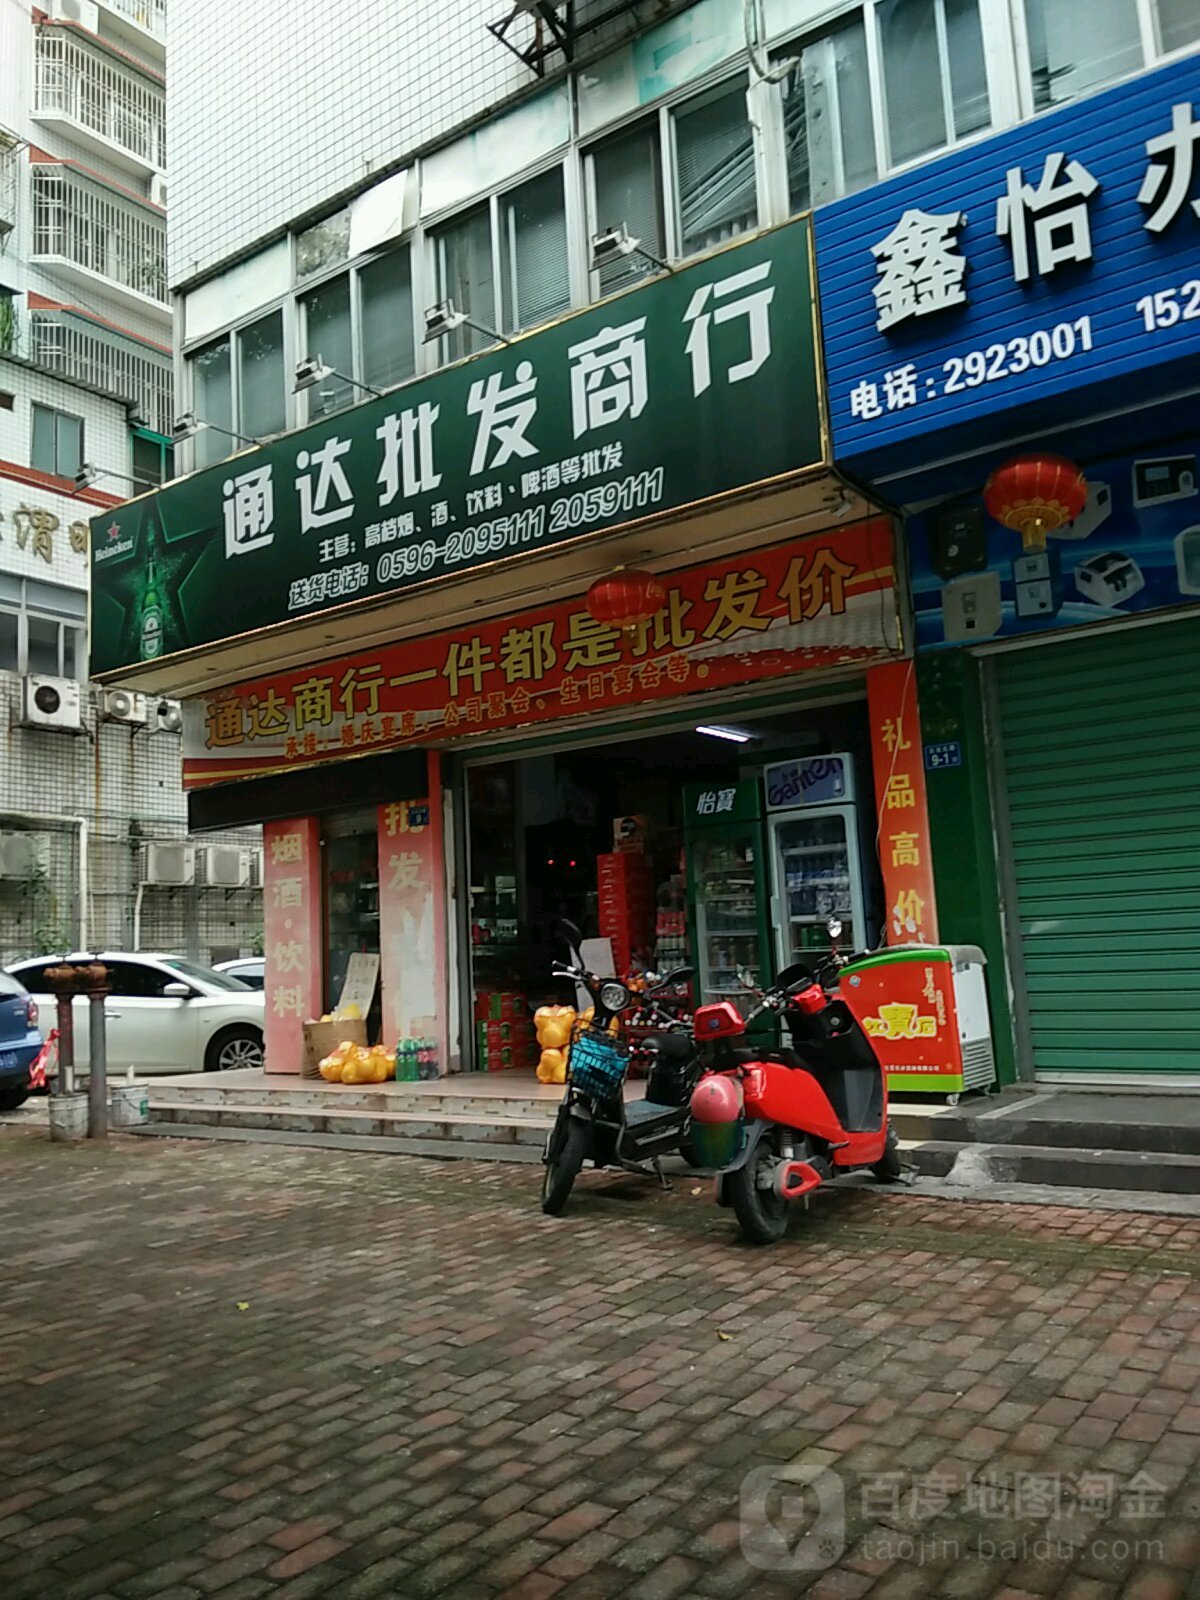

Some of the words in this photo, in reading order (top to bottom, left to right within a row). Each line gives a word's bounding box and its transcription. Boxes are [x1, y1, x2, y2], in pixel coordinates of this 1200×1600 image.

[222, 260, 776, 558] 通达批发商行
[549, 467, 664, 532] 2059111
